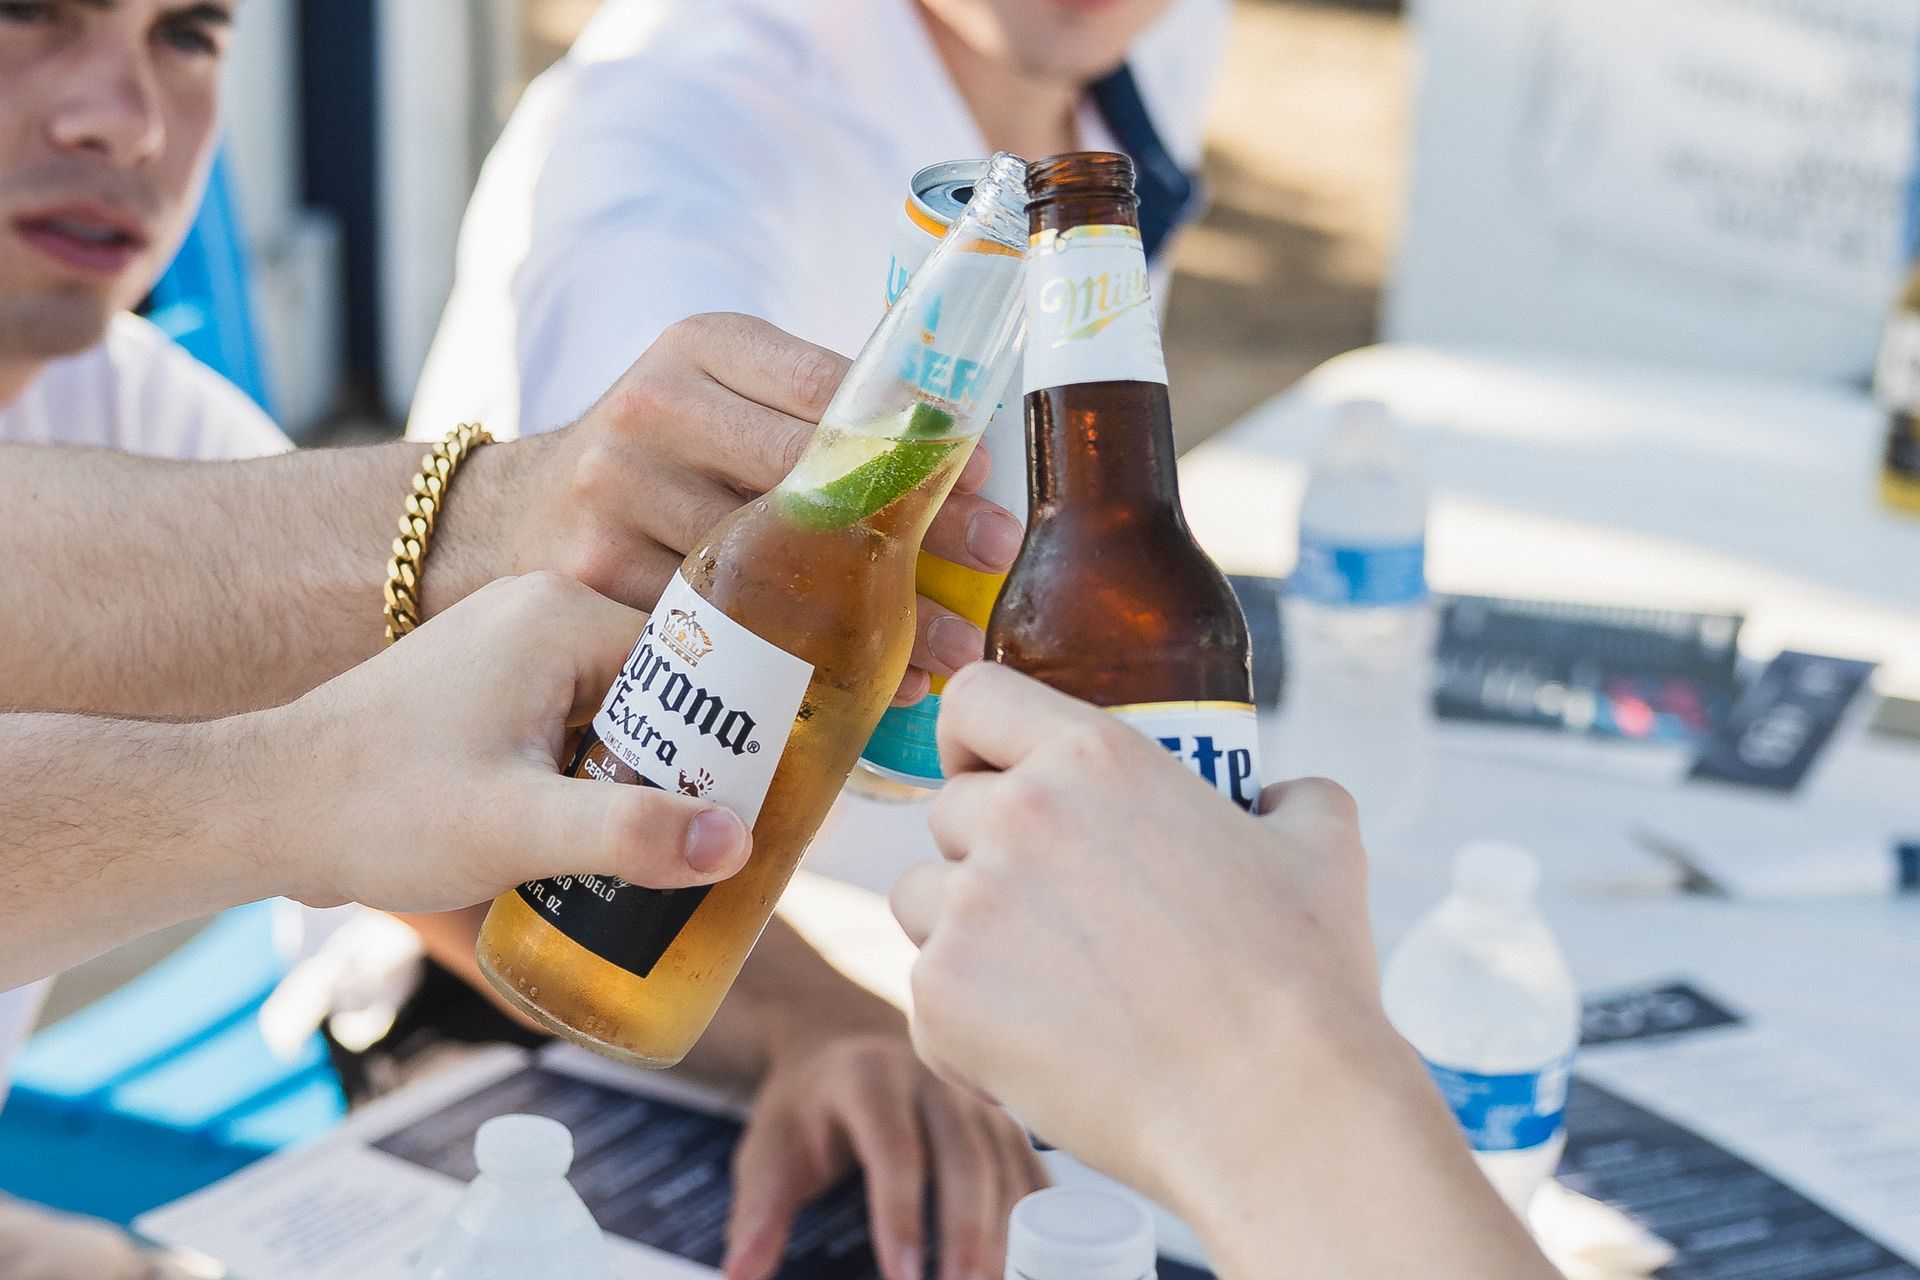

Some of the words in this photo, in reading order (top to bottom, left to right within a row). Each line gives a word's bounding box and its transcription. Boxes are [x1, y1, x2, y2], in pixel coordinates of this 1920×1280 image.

[606, 680, 678, 766] Extra
[604, 731, 622, 753] SINCE
[622, 747, 641, 767] 1925
[601, 757, 617, 777] LA
[532, 883, 544, 902] FL.
[546, 895, 562, 915] OZ.
